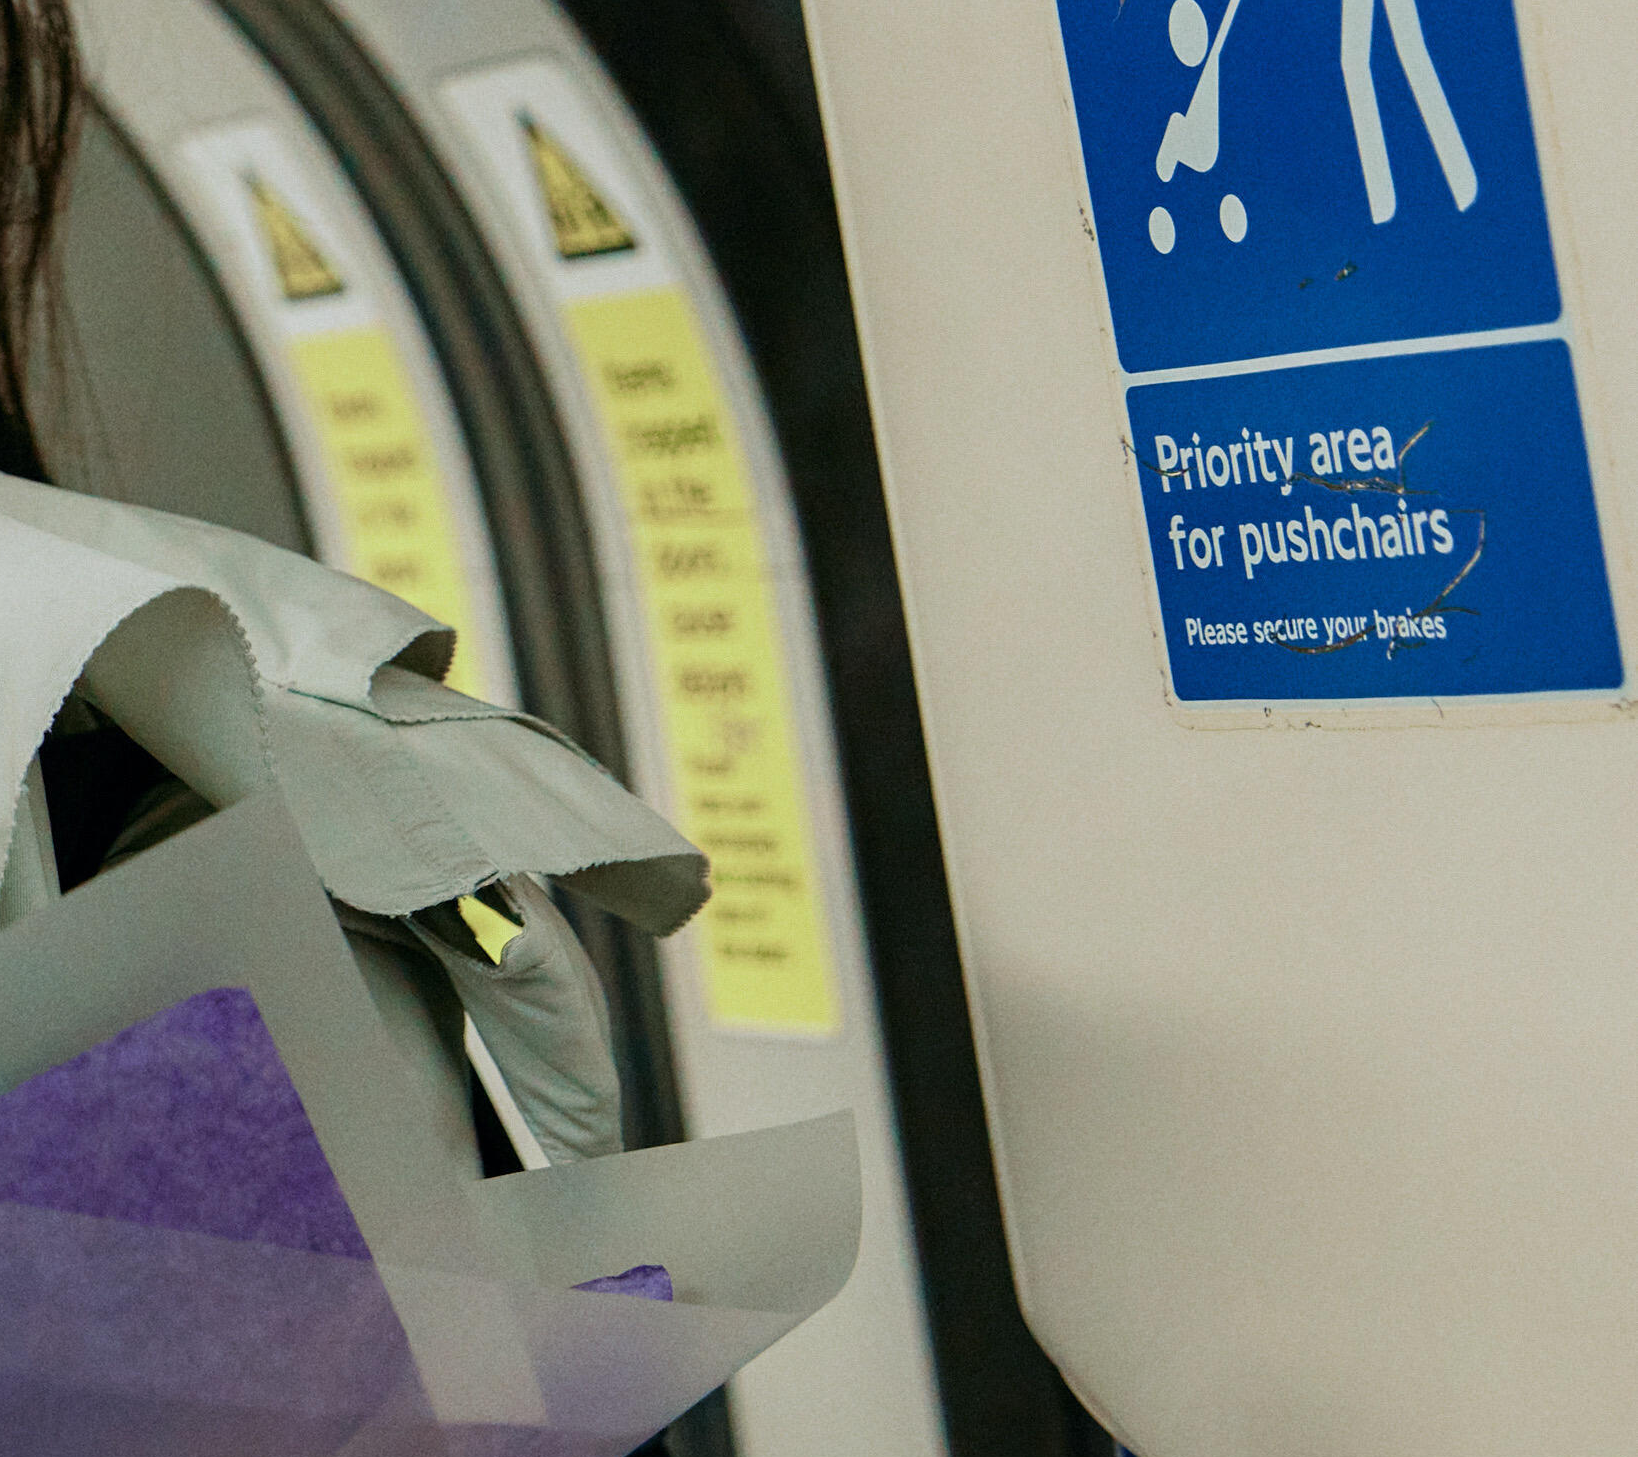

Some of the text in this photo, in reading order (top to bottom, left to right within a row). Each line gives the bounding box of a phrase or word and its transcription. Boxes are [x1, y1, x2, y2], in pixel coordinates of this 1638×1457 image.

[1154, 426, 1396, 496] Priority area
[1169, 498, 1454, 580] for pushchairs
[1185, 607, 1447, 646] Please secure your brakes
